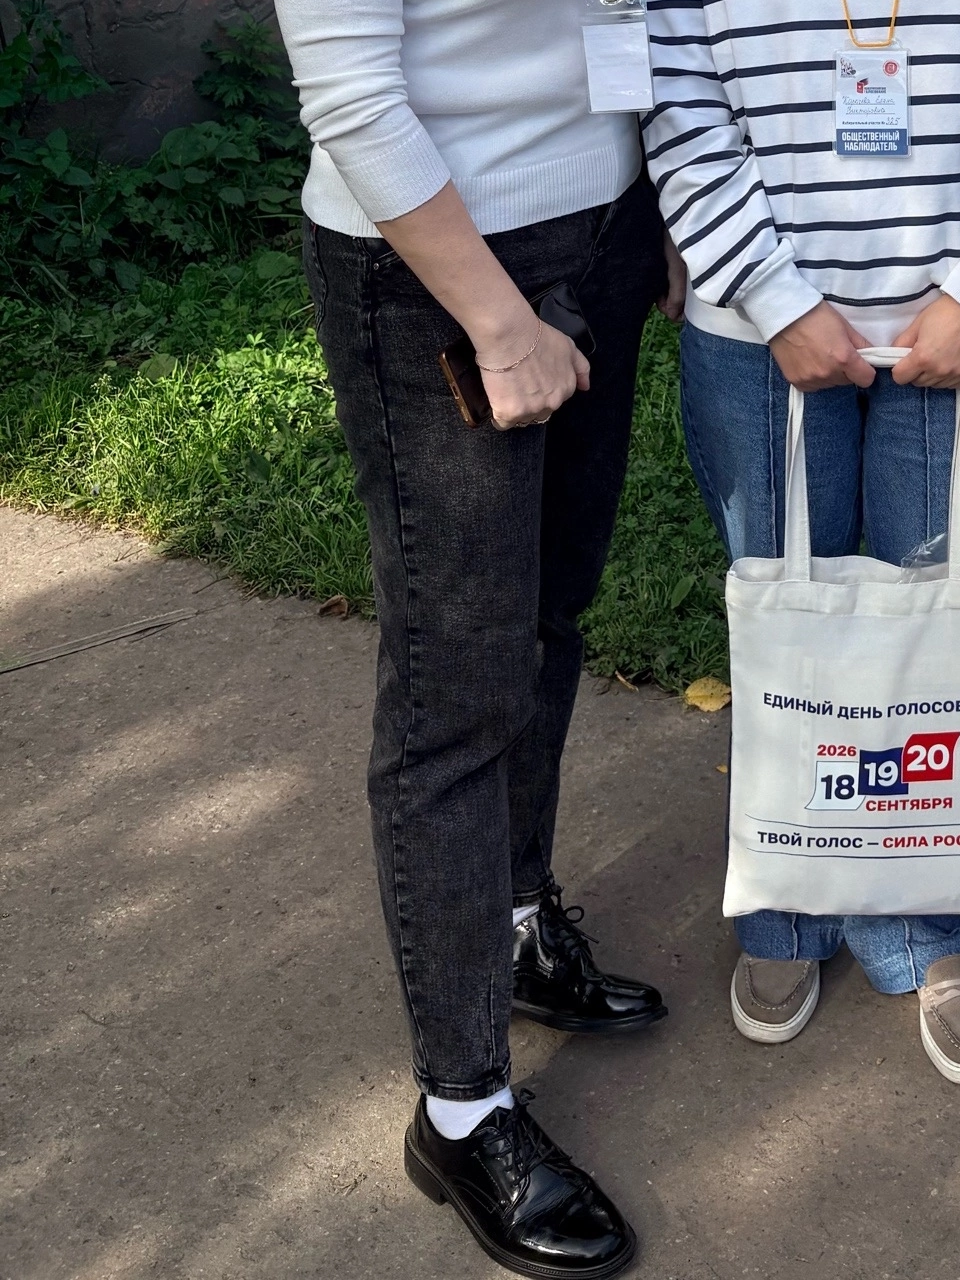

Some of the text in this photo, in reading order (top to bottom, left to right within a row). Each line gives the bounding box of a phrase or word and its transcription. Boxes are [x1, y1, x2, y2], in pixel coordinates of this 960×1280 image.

[842, 131, 900, 141] ОБЩЕСТВЕННЫЙ
[845, 141, 897, 152] НАБЛЮДАТЕЛЬ
[764, 693, 832, 715] ЕДИНЫЙ
[837, 706, 882, 720] ДЕНЬ
[817, 745, 856, 756] 2026
[821, 744, 949, 800] 18 19 20
[866, 797, 952, 812] СЕНТЯБРЯ
[758, 832, 801, 846] ТВОЙ
[807, 837, 862, 848] ГОЛОС
[883, 836, 928, 848] СИЛА
